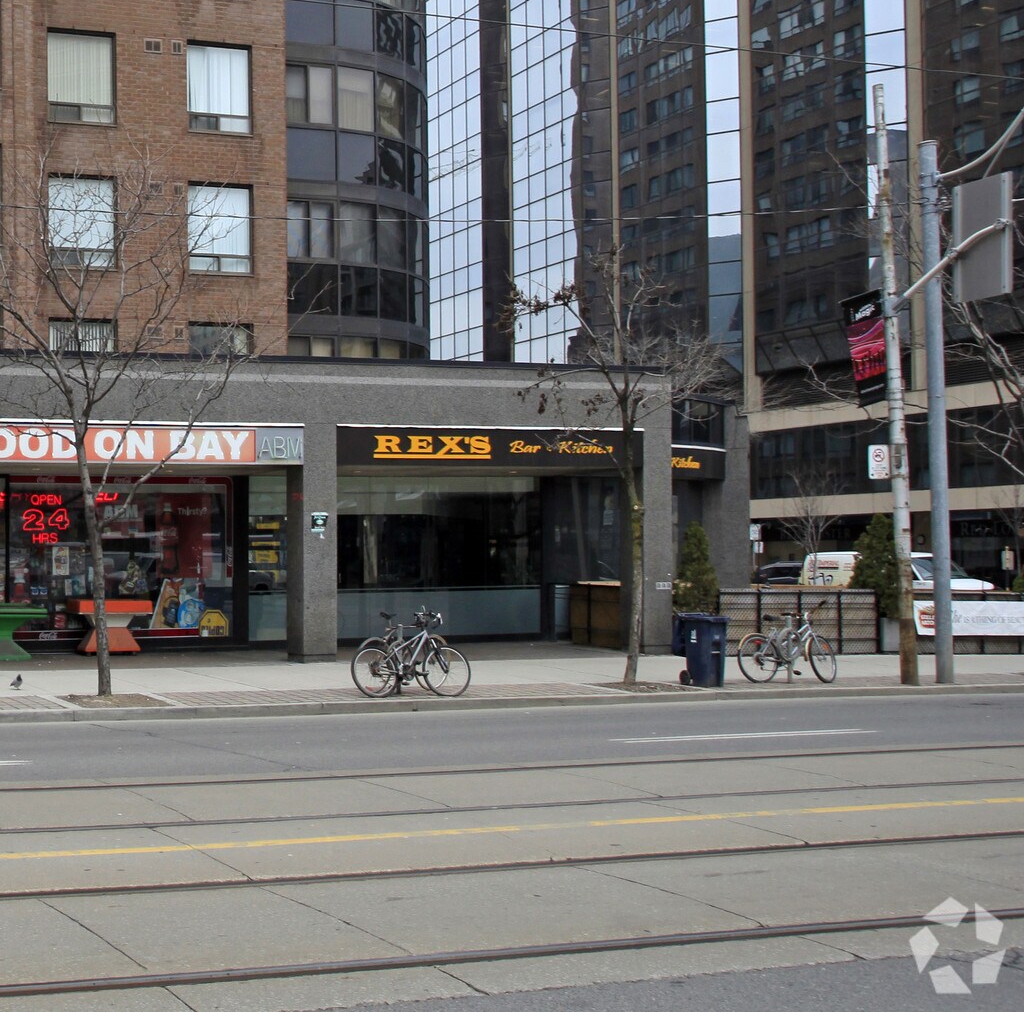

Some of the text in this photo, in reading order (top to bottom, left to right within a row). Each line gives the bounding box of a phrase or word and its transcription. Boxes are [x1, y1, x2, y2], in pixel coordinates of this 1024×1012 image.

[94, 430, 154, 460] ON
[169, 430, 250, 460] BAY
[258, 435, 303, 458] ABM
[373, 435, 491, 455] REX'S
[509, 440, 541, 454] Bar
[30, 494, 62, 506] OPEN
[22, 508, 70, 531] 24
[32, 533, 58, 544] HRS
